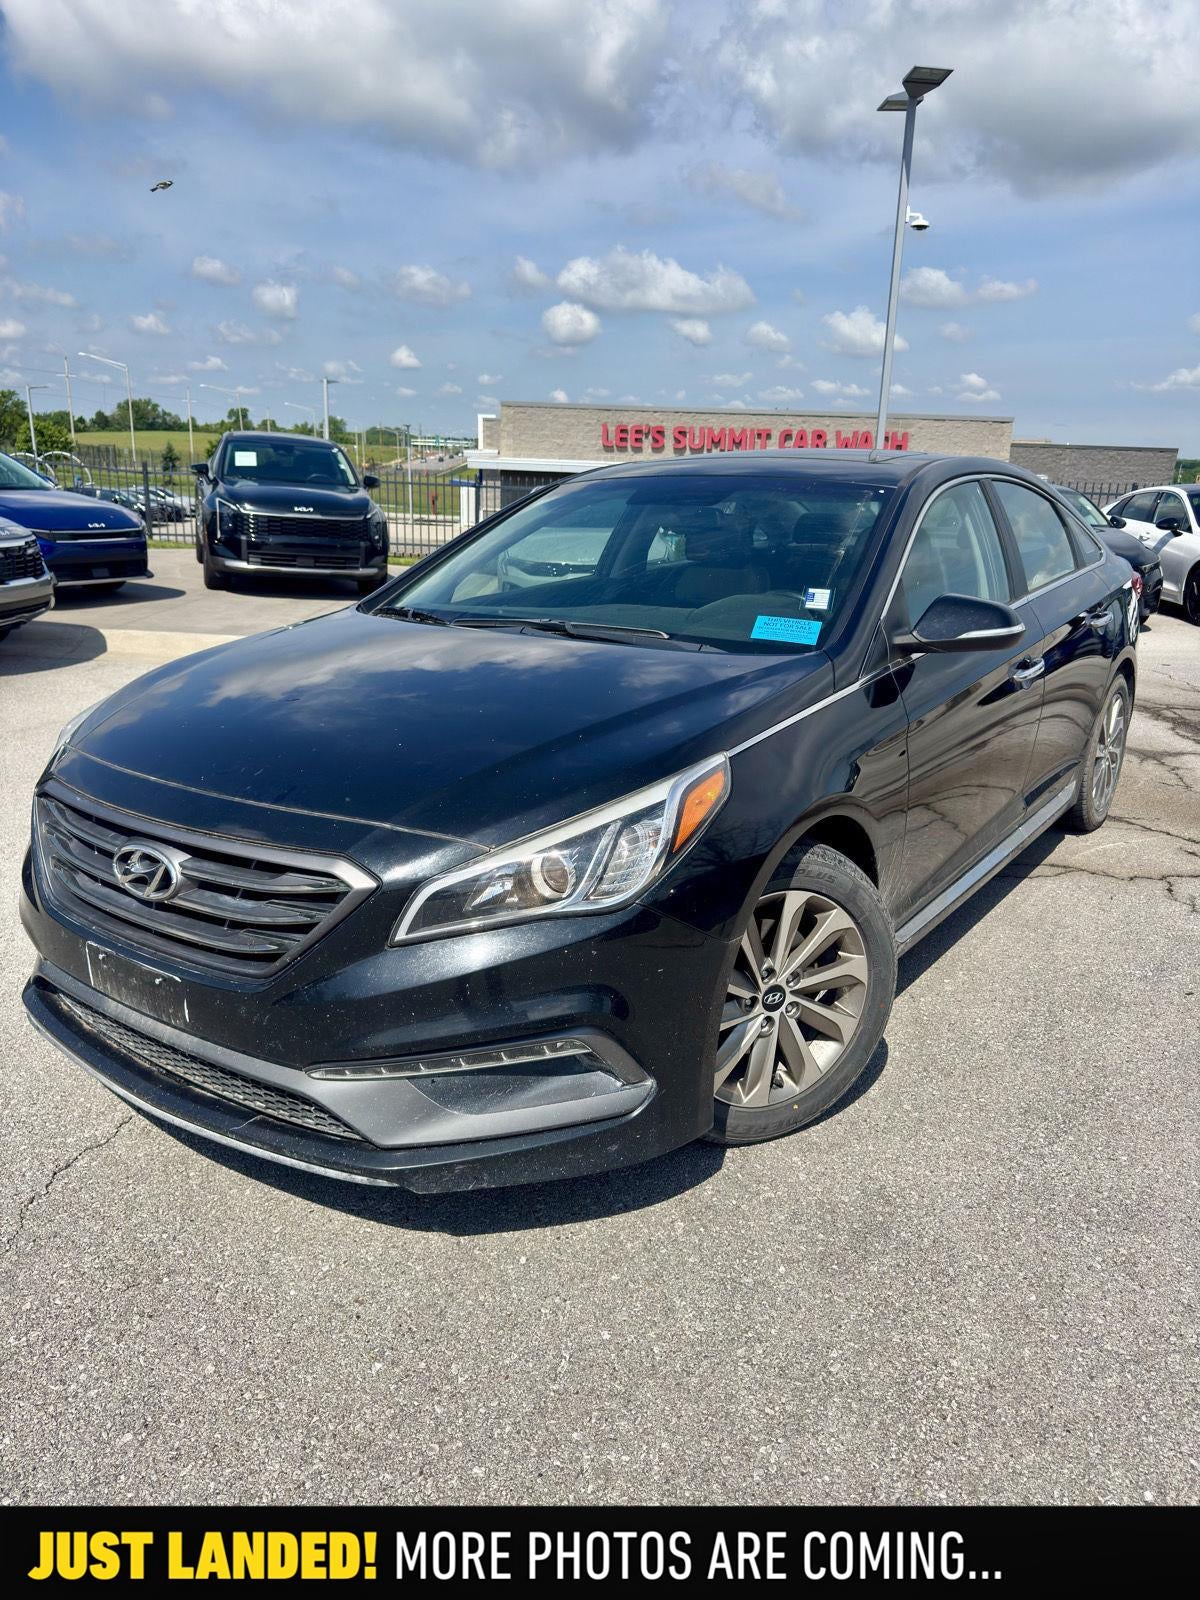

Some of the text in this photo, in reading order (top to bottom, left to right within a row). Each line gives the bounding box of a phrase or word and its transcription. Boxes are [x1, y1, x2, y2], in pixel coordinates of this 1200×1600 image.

[601, 423, 666, 449] LEE'S
[672, 426, 772, 451] SUMMIT
[778, 429, 828, 449] CAR
